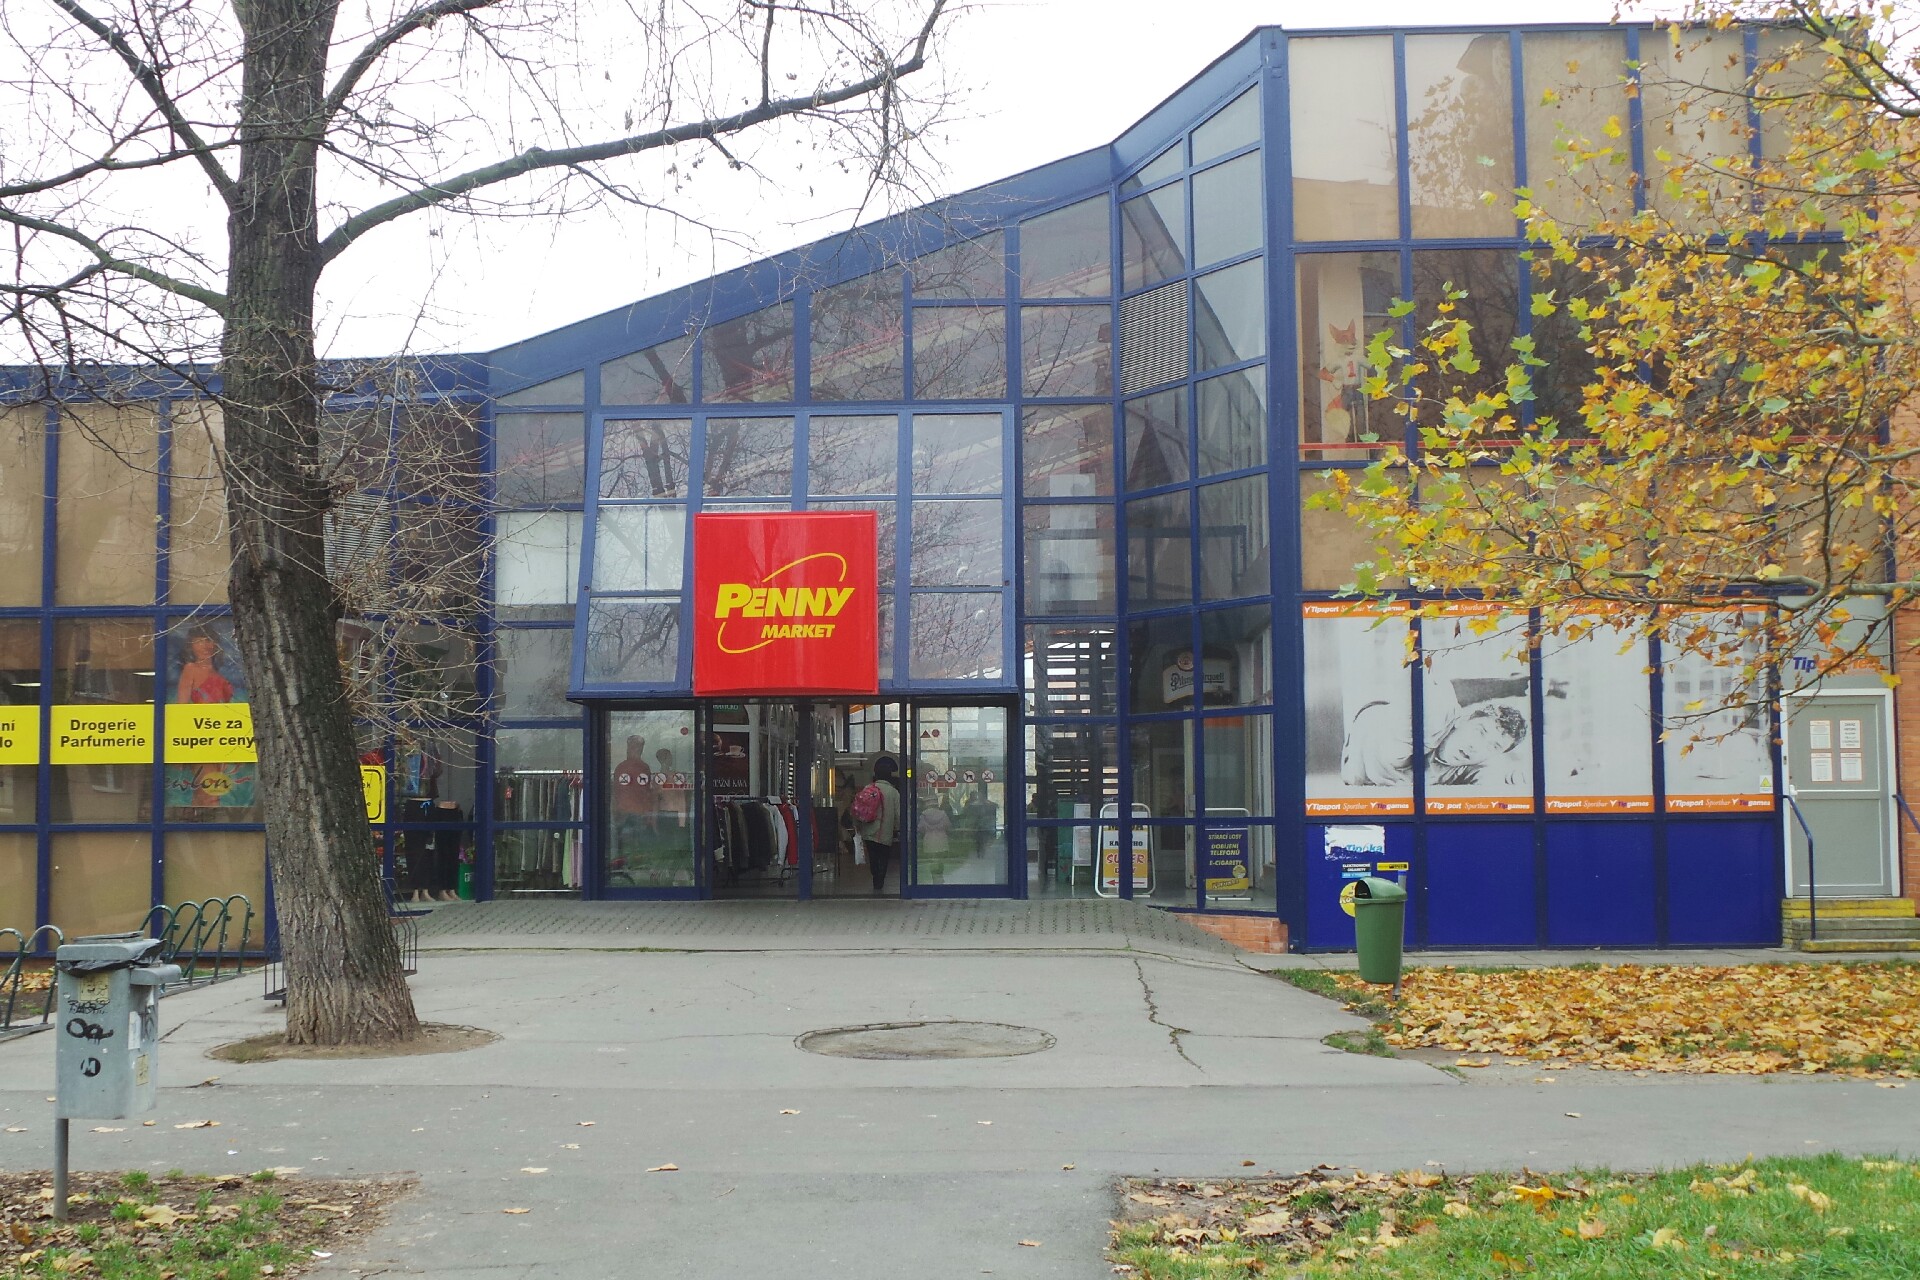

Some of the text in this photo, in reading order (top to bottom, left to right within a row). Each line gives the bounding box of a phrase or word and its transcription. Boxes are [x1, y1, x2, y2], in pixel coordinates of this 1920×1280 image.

[715, 583, 855, 618] PENNY
[1311, 605, 1339, 613] Tipsport
[761, 624, 835, 638] MARKET
[1, 719, 15, 731] ní
[70, 718, 136, 733] Drogerie
[193, 717, 242, 729] Vše za
[60, 735, 145, 747] Parfumerie
[172, 737, 255, 749] super ceny
[1433, 802, 1462, 810] Tipport
[1554, 801, 1582, 809] Tipsport
